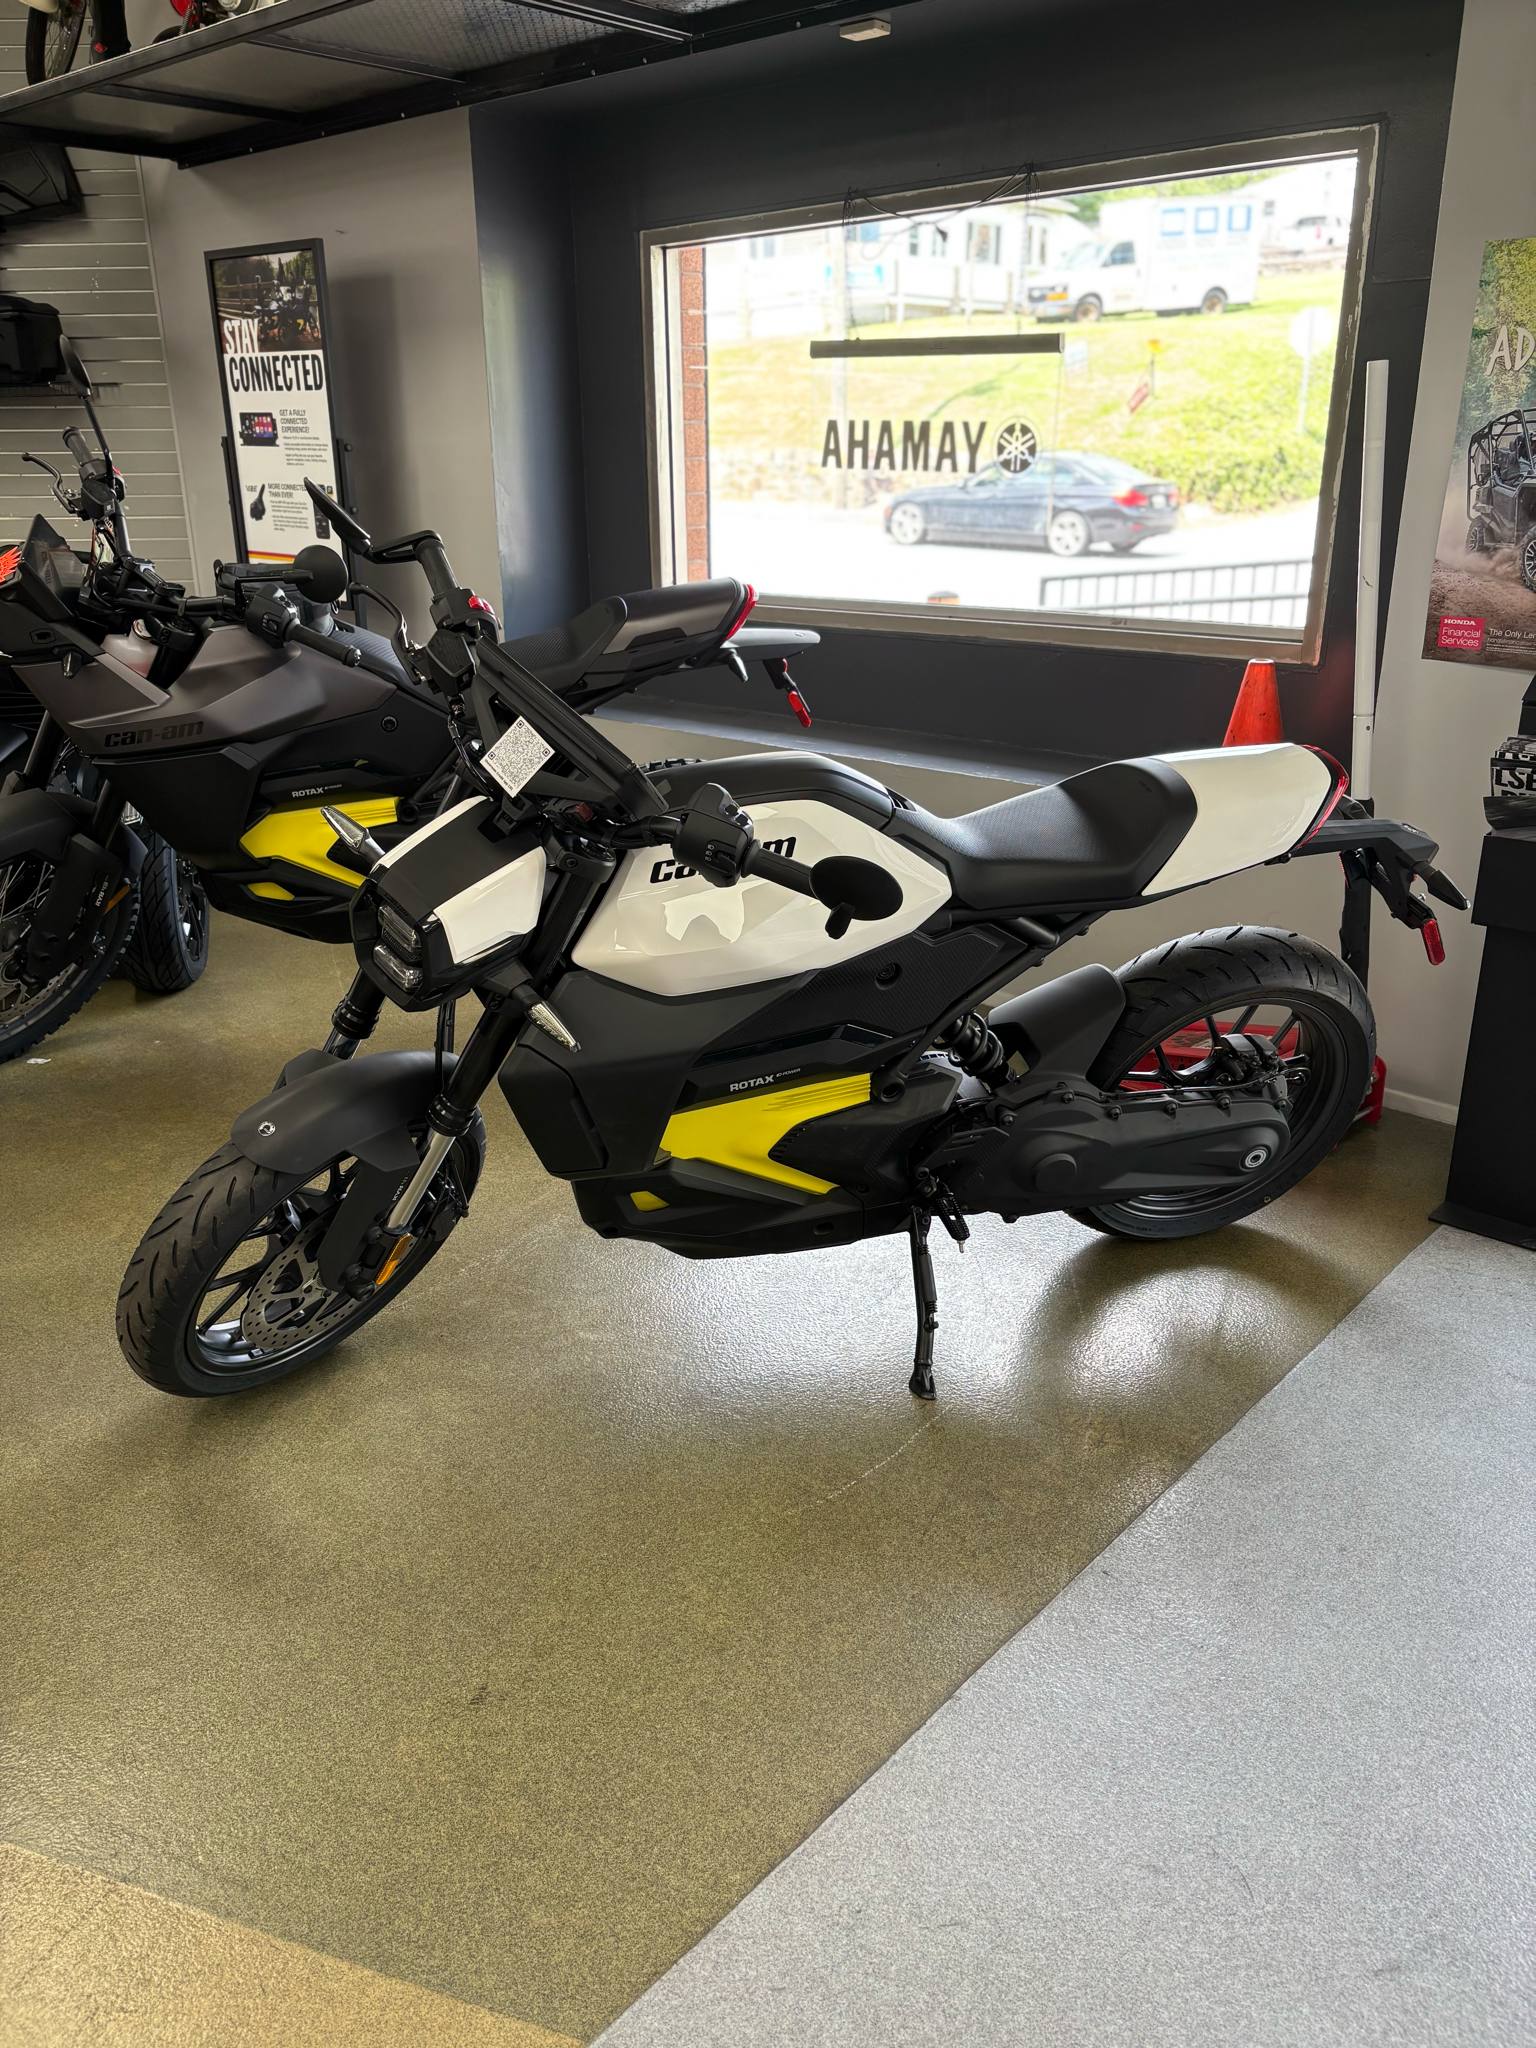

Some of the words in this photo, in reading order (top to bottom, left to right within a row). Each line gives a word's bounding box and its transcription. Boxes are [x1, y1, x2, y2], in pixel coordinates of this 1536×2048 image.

[223, 319, 259, 354] STAY
[229, 354, 323, 392] CONNECTED
[1443, 618, 1476, 626] HONDA
[1442, 627, 1481, 638] Financial
[1489, 629, 1503, 637] The
[1505, 630, 1522, 639] Only
[1441, 636, 1479, 647] Services
[104, 721, 204, 747] can-am
[292, 787, 324, 798] ROTAX
[729, 1074, 774, 1092] ROTAX
